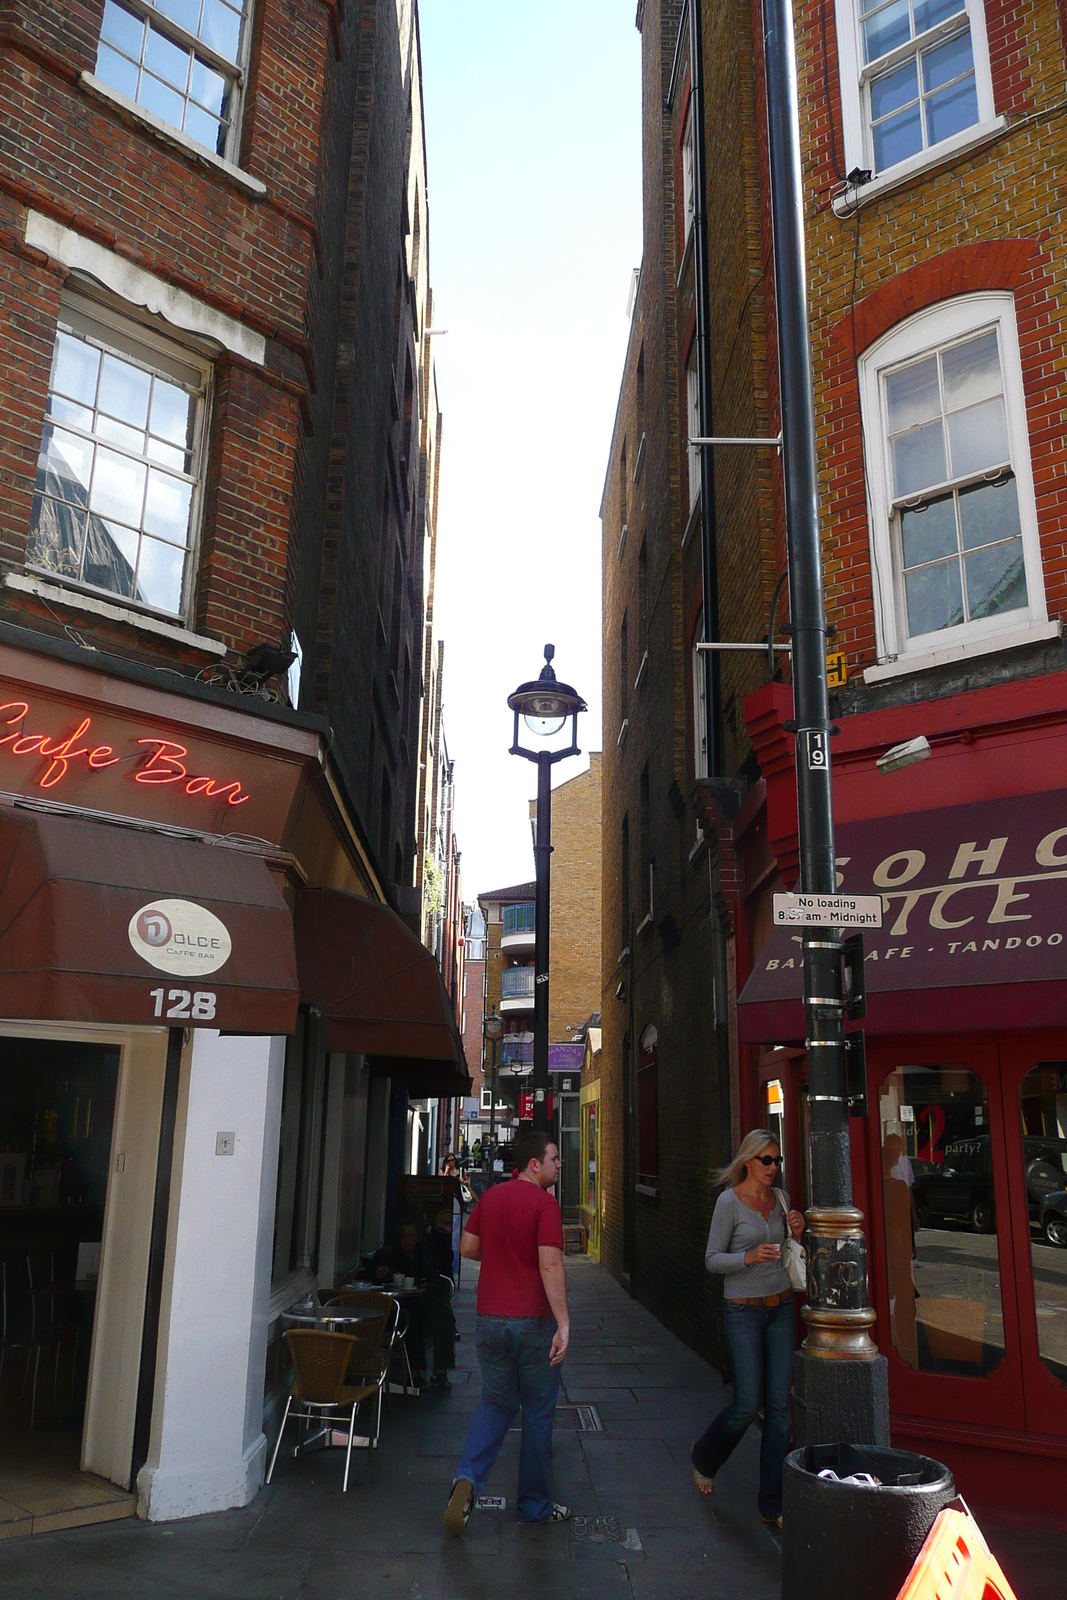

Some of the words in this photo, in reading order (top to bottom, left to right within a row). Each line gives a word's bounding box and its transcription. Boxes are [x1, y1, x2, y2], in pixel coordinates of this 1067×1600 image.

[0, 702, 120, 788] Cafe
[135, 738, 250, 804] Bar
[798, 898, 814, 907] No
[817, 898, 856, 909] loading
[830, 912, 877, 923] Midnight
[143, 914, 220, 949] DOLCE
[198, 952, 215, 960] BAR
[864, 946, 914, 962] AFE
[150, 987, 217, 1020] 128
[918, 1105, 945, 1163] 2
[945, 1143, 982, 1156] party?
